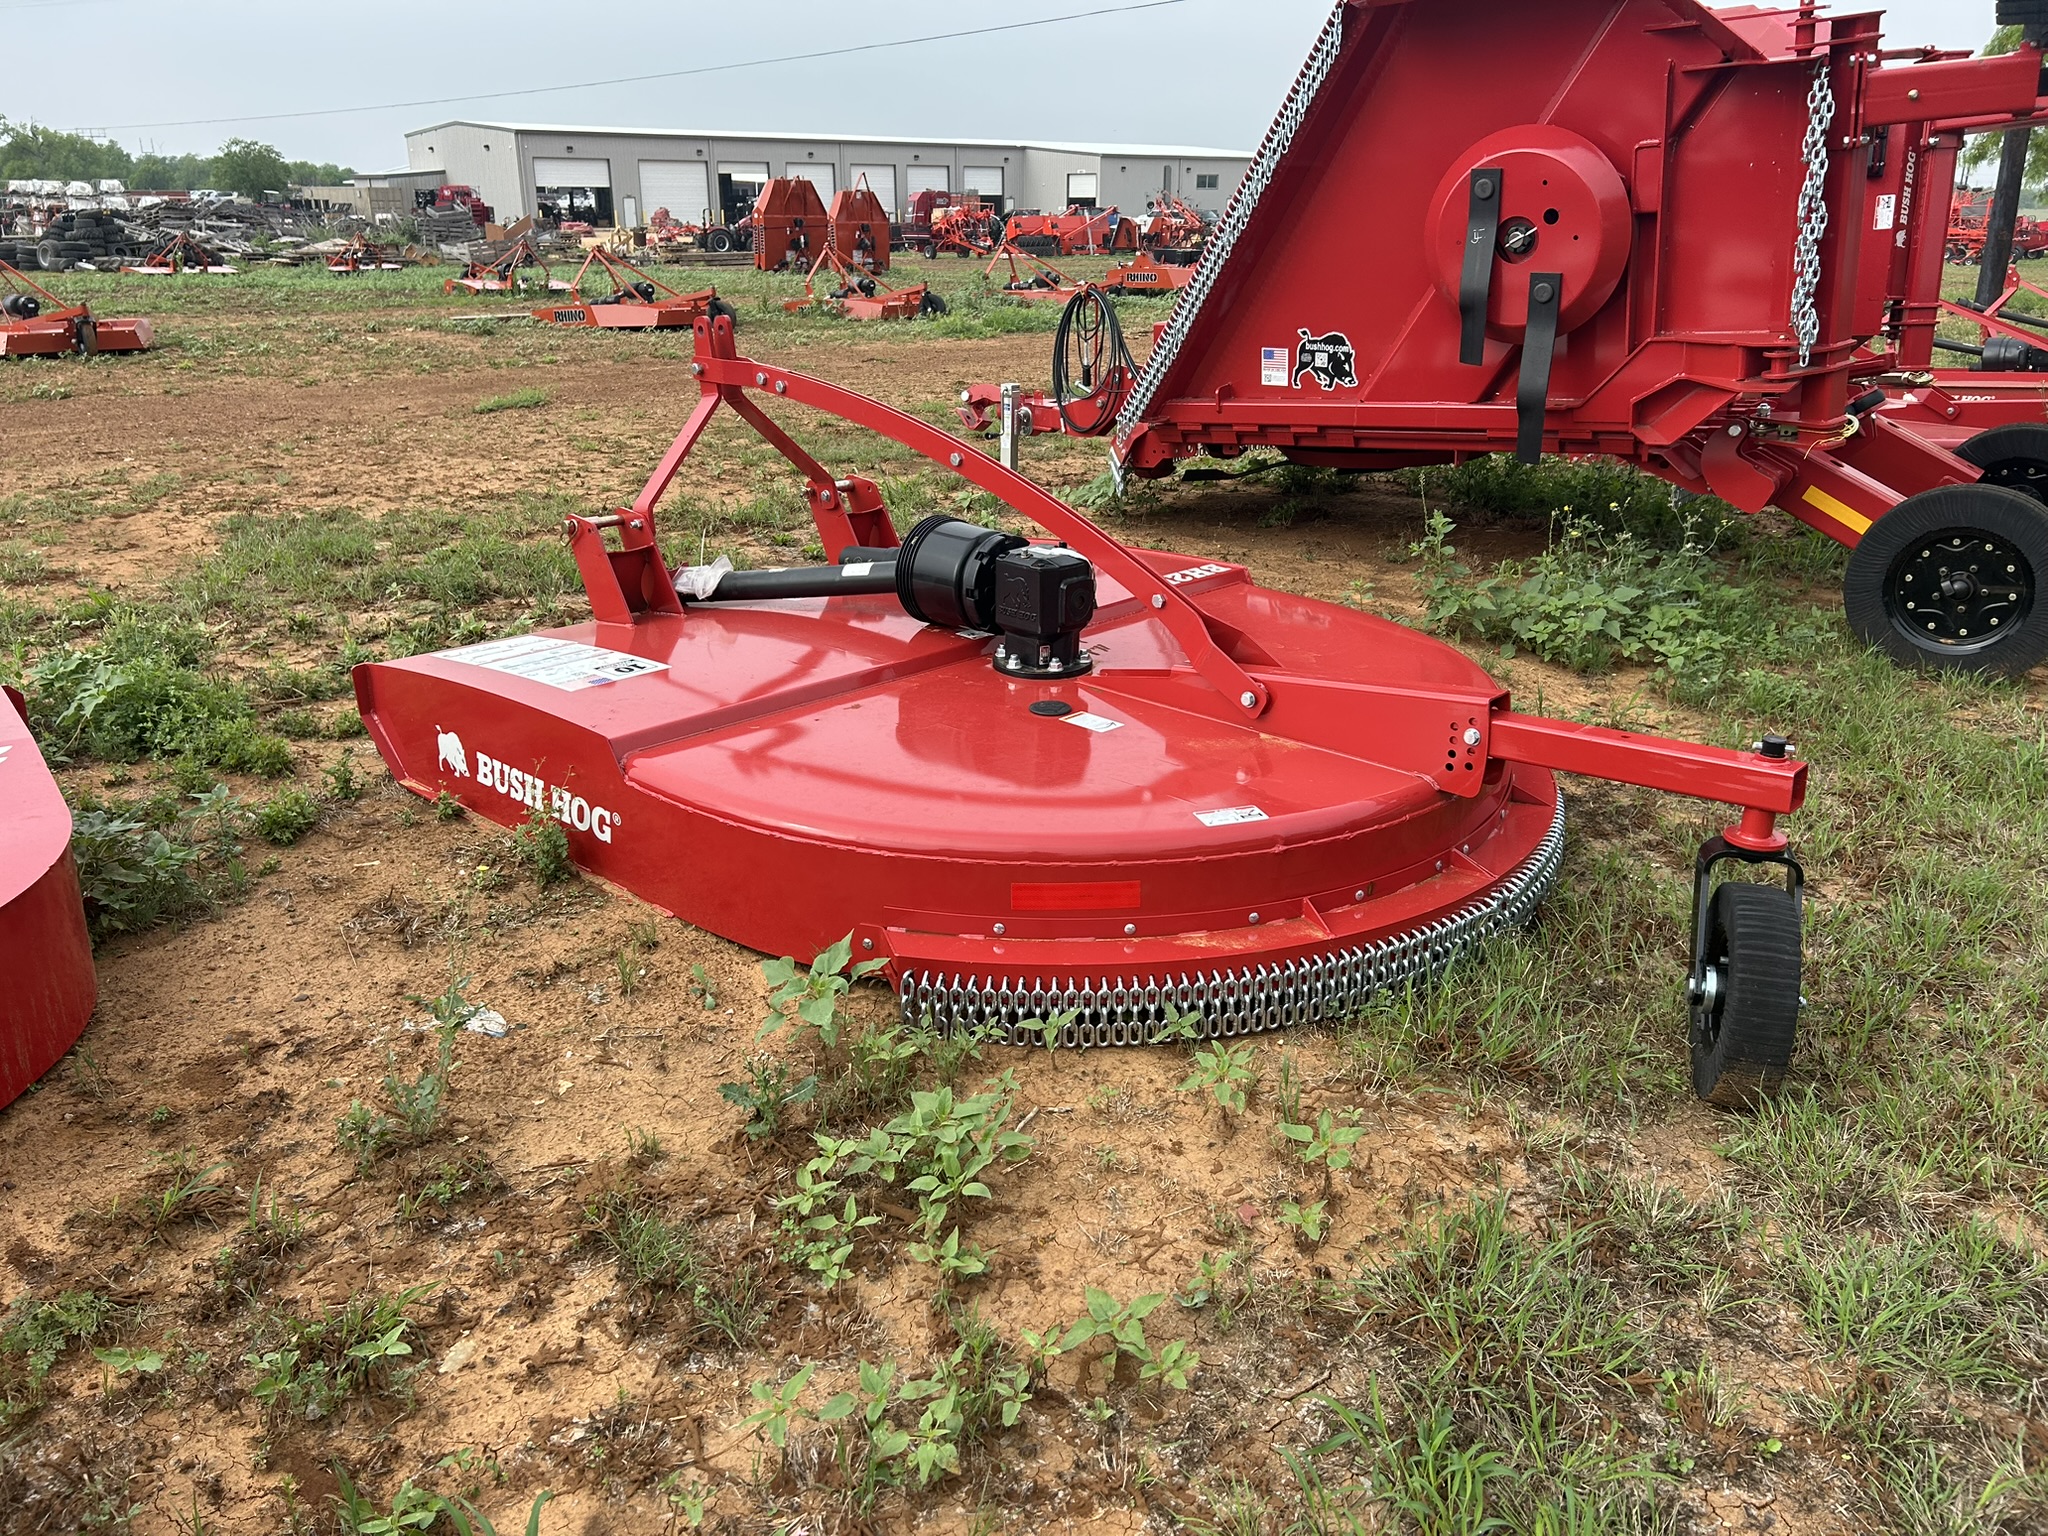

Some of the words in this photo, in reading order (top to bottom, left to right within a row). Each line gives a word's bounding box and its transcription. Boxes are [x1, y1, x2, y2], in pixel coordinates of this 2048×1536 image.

[1905, 151, 1917, 185] HOG
[1899, 186, 1912, 225] BUSH
[1126, 273, 1157, 282] RHINO
[553, 309, 586, 322] RHINO
[1305, 341, 1350, 354] bushhog.com
[476, 751, 545, 812] BUSH
